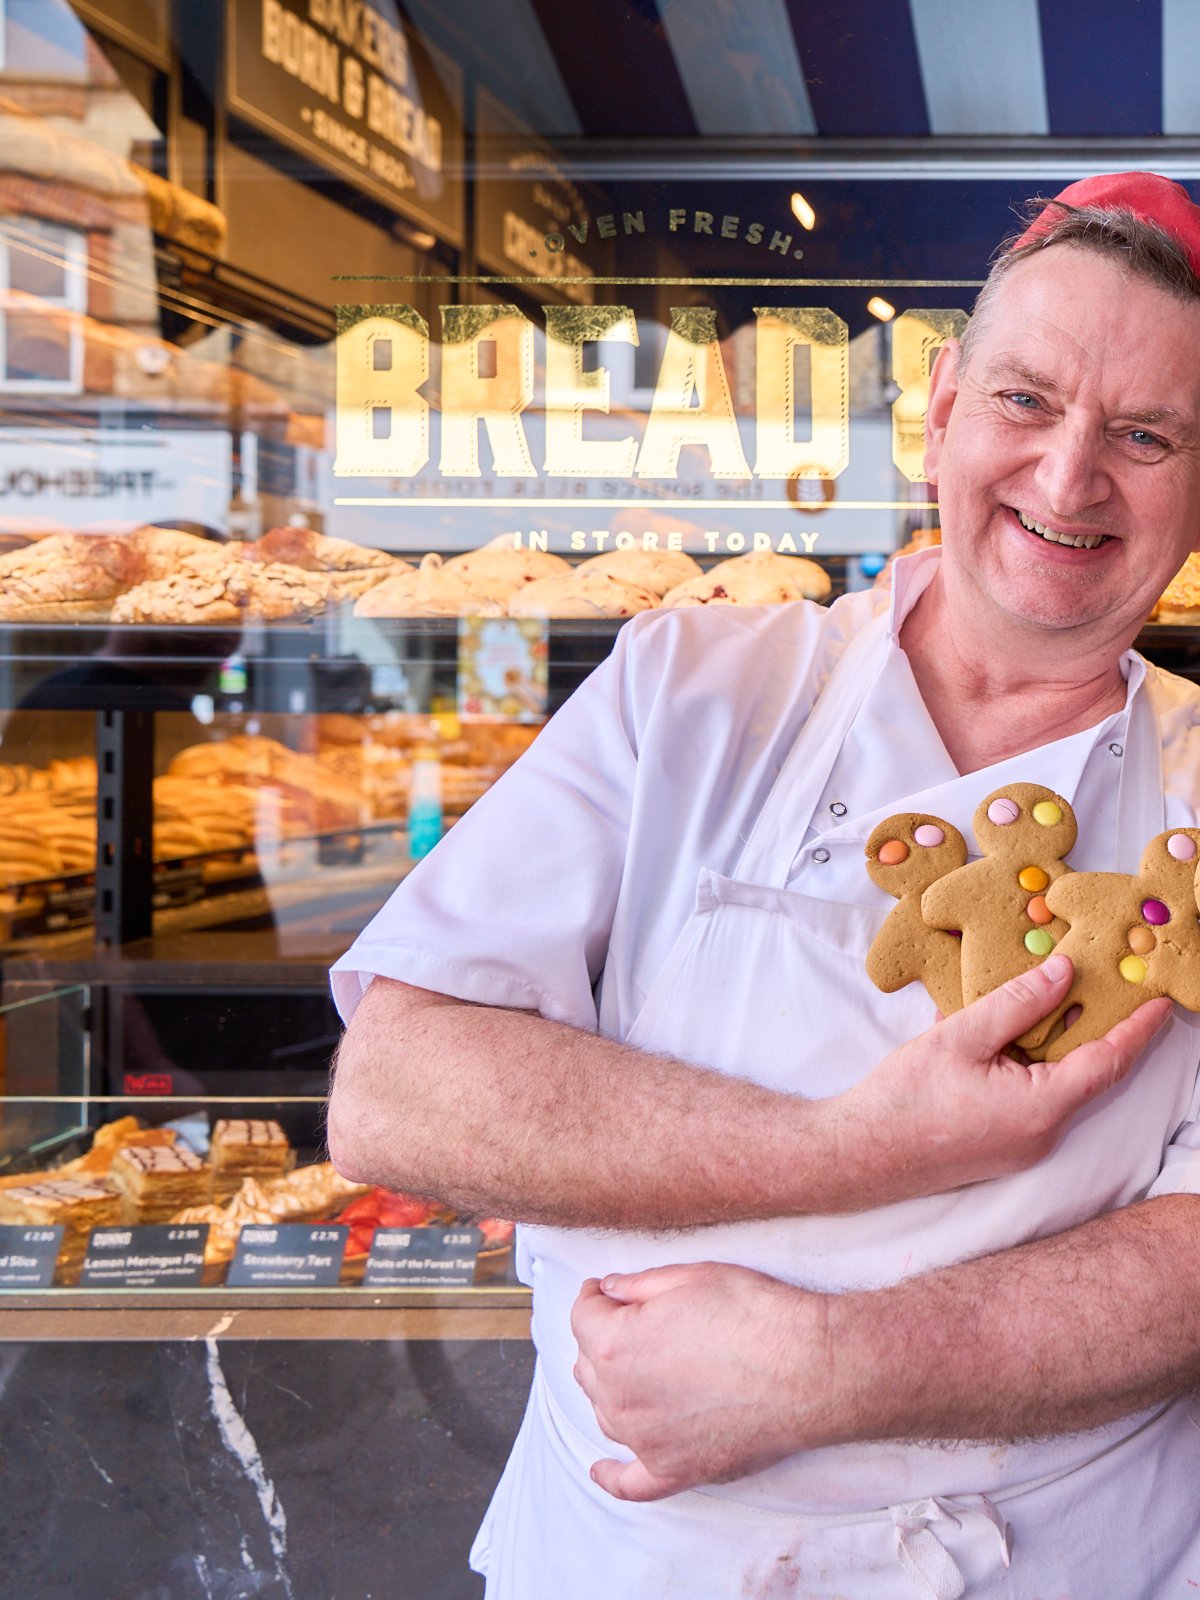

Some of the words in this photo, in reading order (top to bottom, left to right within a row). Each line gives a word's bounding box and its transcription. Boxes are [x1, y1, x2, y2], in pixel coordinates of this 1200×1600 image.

[262, 0, 340, 104] BORN
[544, 210, 647, 253] OVEN
[333, 304, 850, 480] BREAD
[514, 530, 548, 551] IN
[570, 531, 684, 551] STORE
[704, 531, 819, 552] TODAY
[9, 1255, 38, 1267] Slice
[84, 1258, 125, 1269] Lemon
[126, 1255, 182, 1268] Meringue
[183, 1252, 203, 1265] Pie
[243, 1254, 306, 1268] Strawberry
[307, 1254, 332, 1267] Tart
[367, 1258, 394, 1269] Fruits
[396, 1257, 407, 1269] of
[407, 1257, 423, 1269] the
[424, 1258, 453, 1269] Forest
[455, 1259, 475, 1270] Tart
